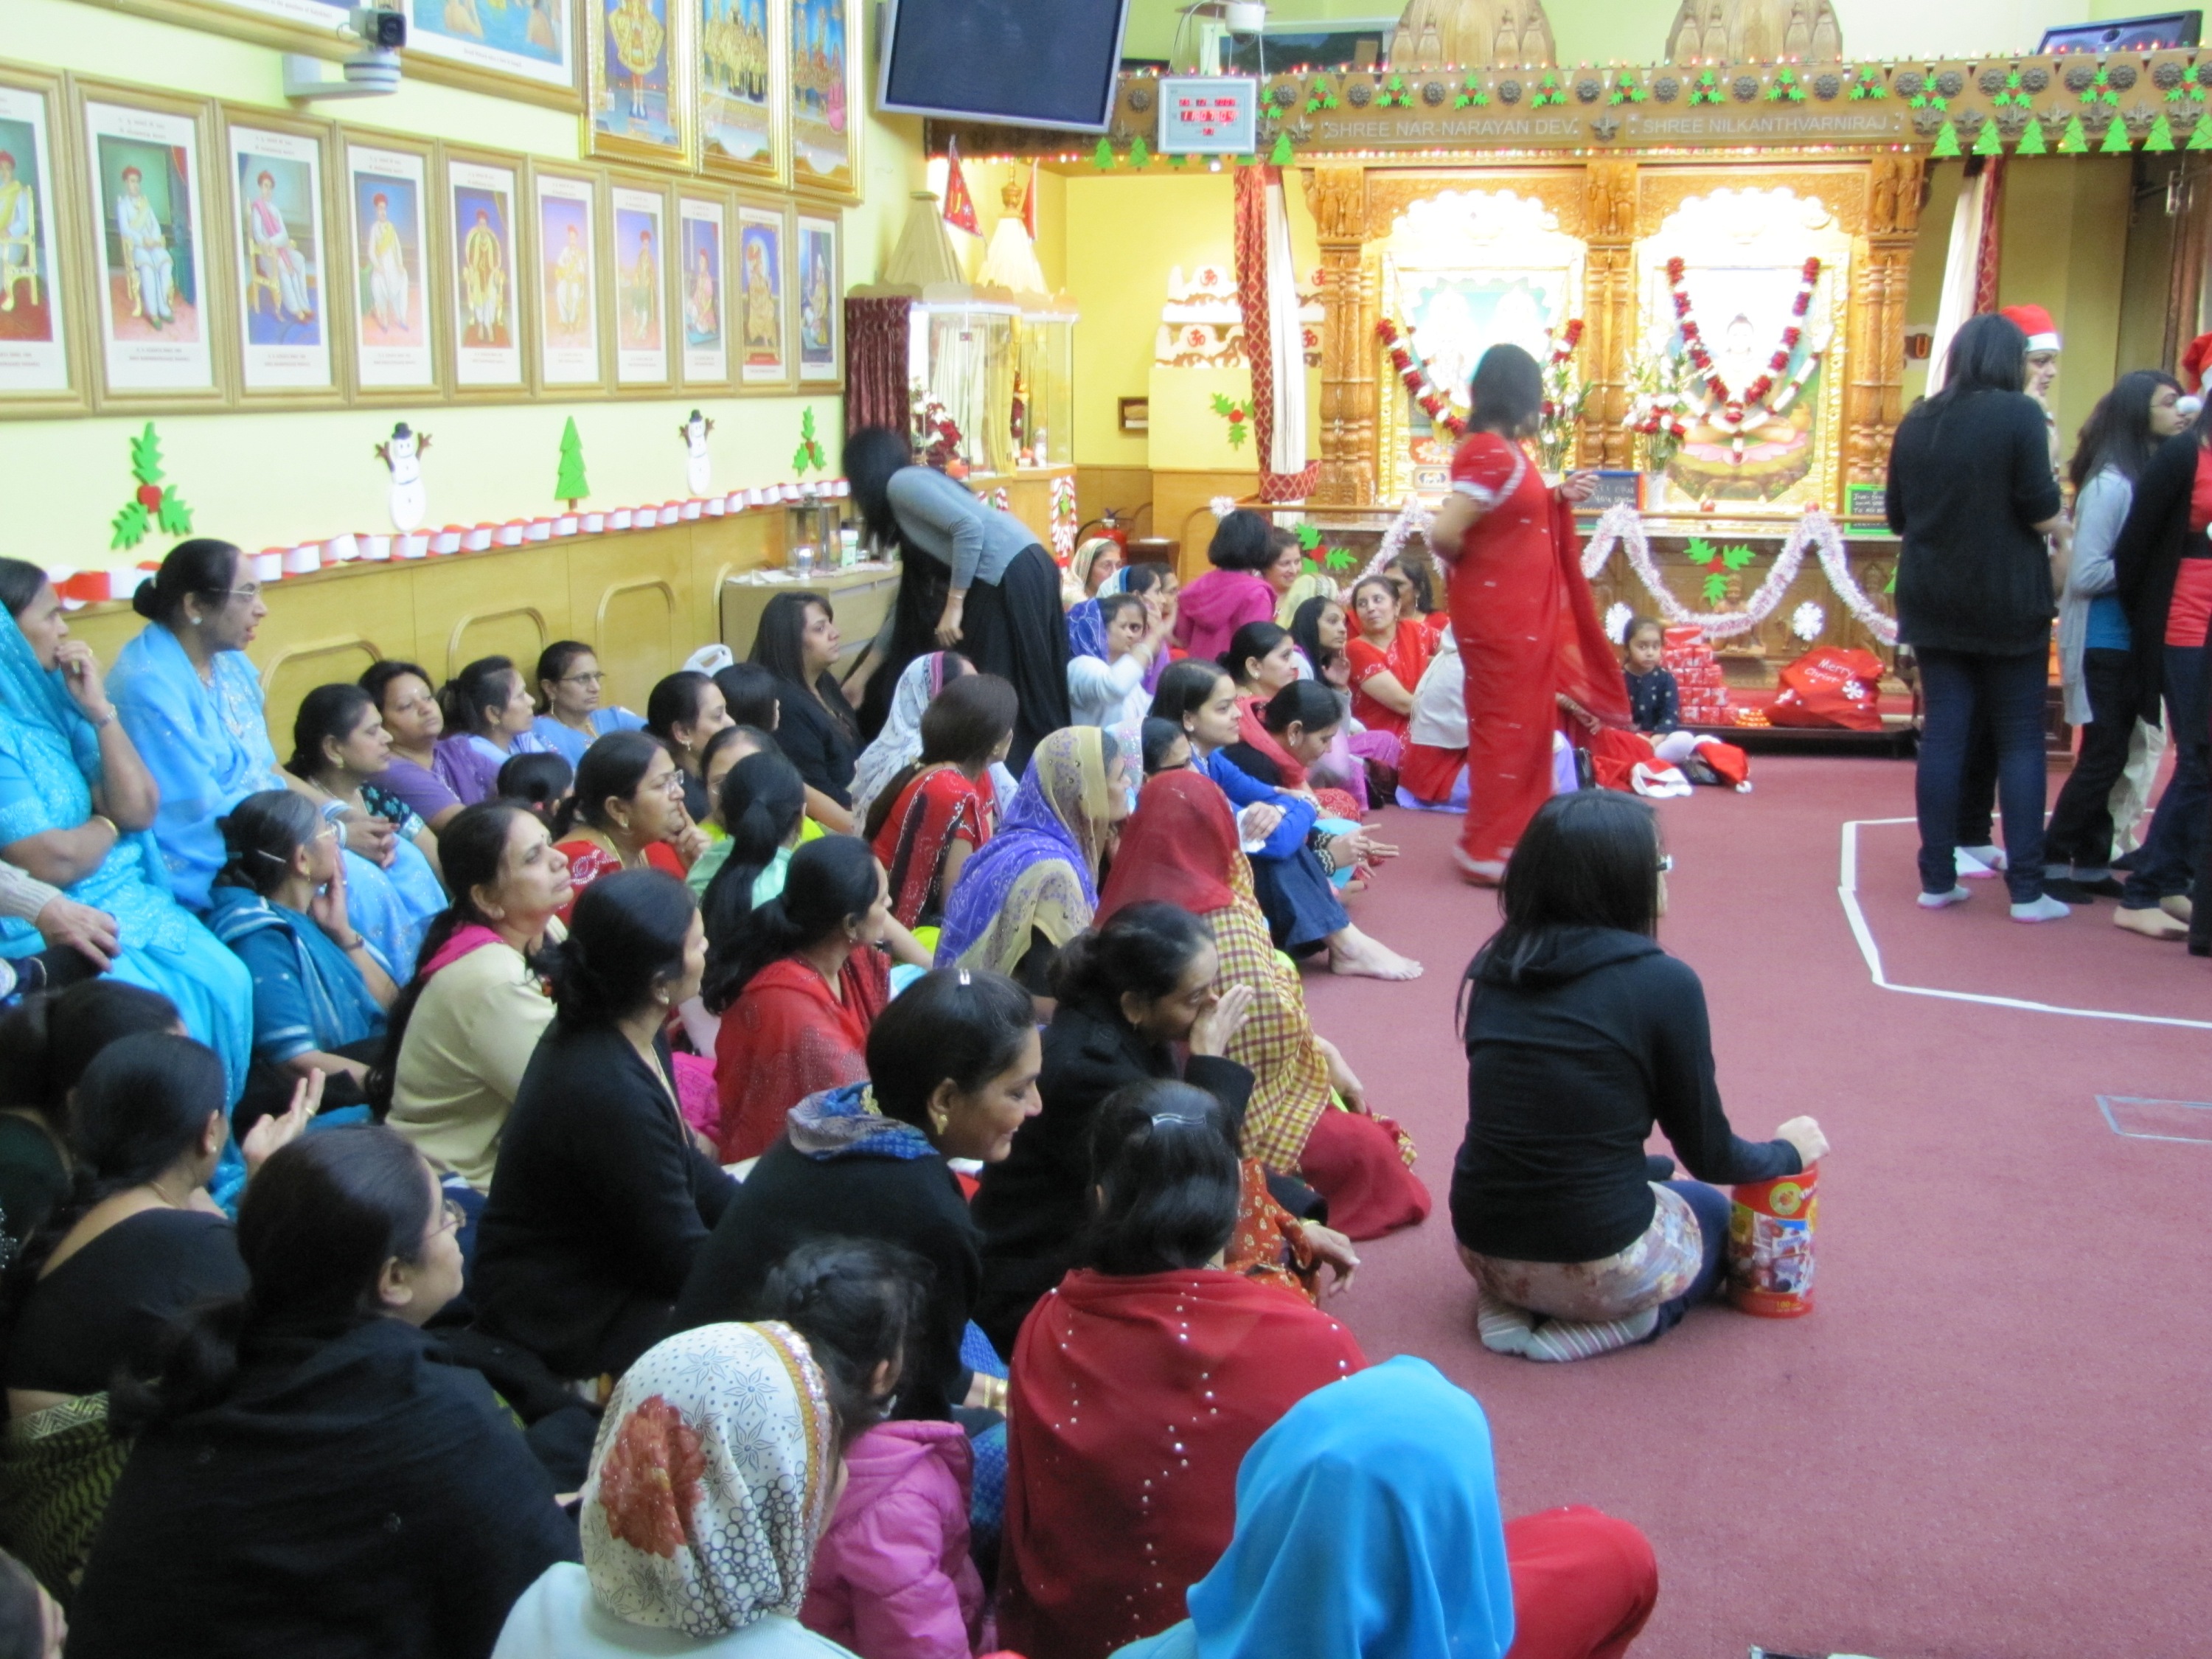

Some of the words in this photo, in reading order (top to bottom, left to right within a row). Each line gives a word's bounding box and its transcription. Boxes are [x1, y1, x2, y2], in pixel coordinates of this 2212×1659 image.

[1328, 121, 1390, 138] SHREE
[1397, 120, 1528, 137] NAR-NARAYAN
[1643, 118, 1703, 134] SHREE
[1709, 116, 1887, 133] NILKANTHVARNIRAJ
[1818, 658, 1855, 679] Merry
